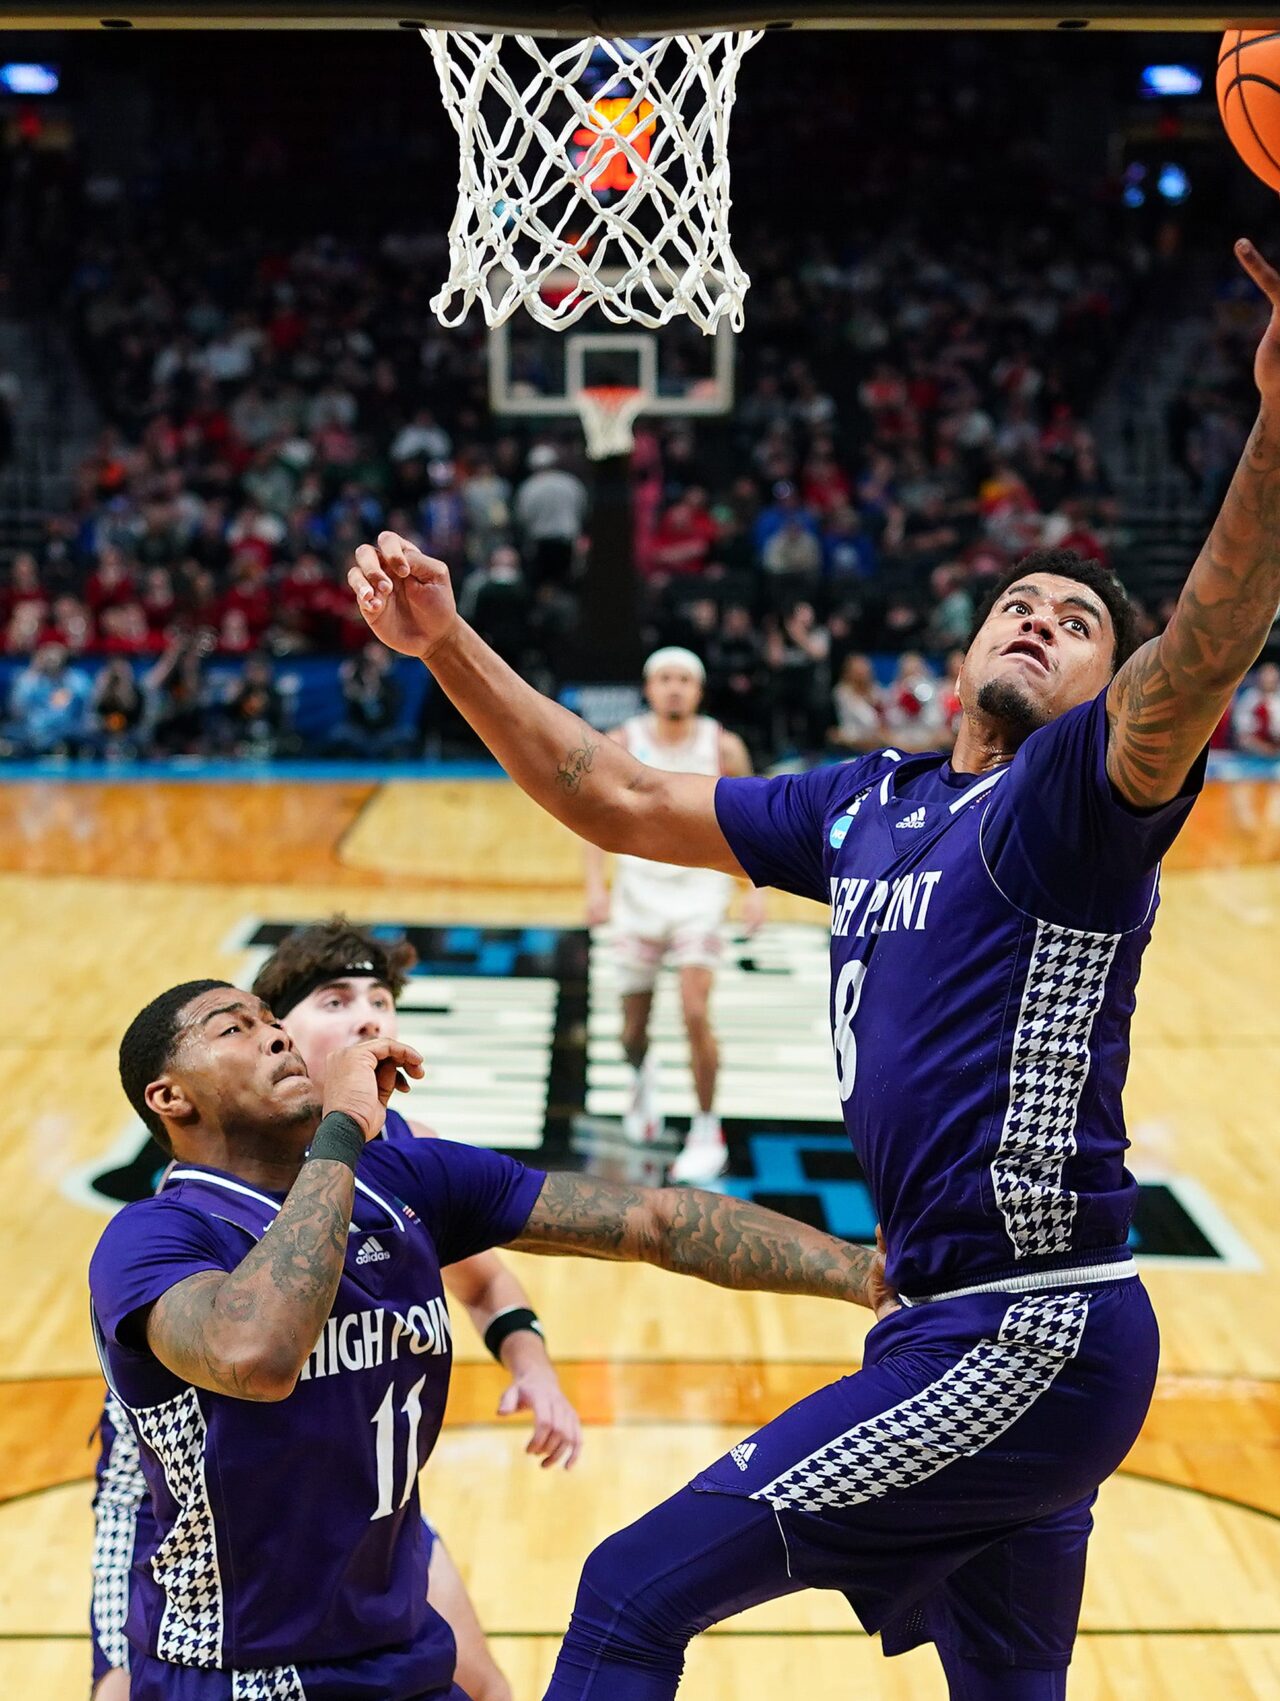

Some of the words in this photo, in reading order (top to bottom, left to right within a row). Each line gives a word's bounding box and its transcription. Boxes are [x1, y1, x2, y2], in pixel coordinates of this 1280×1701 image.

[355, 1249, 390, 1265] adidas
[300, 1307, 385, 1381] HIGH
[371, 1374, 426, 1521] 11
